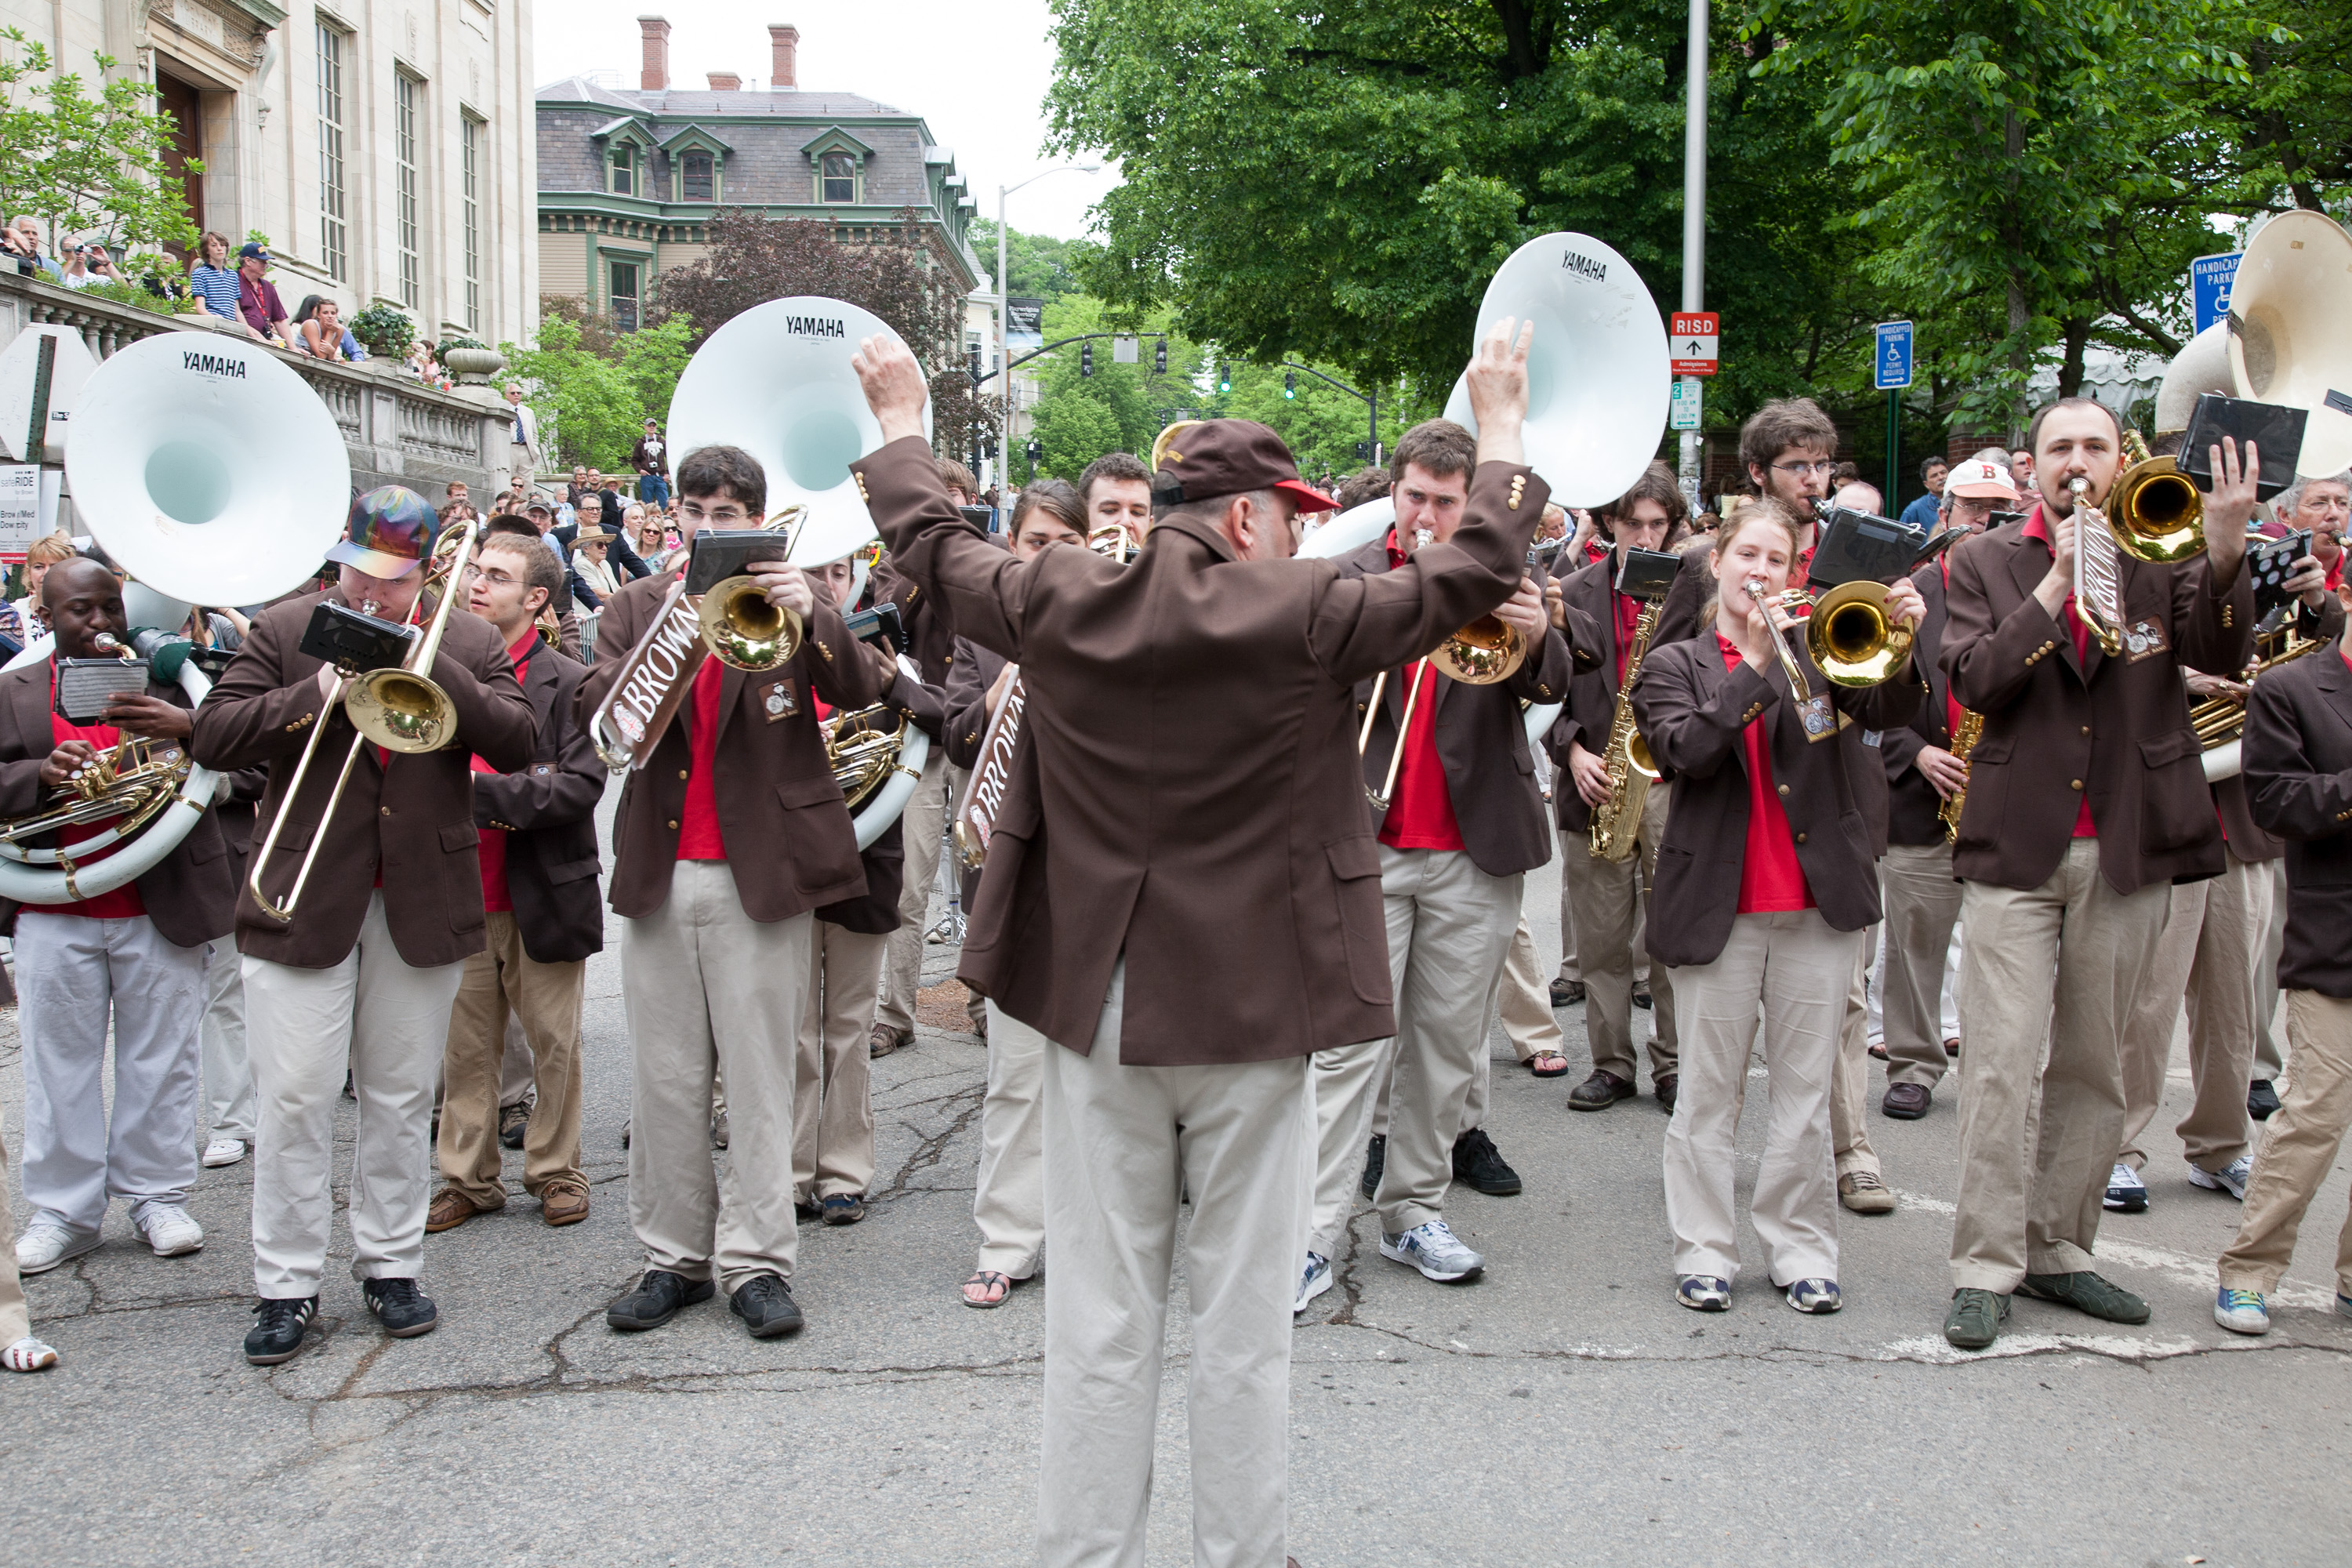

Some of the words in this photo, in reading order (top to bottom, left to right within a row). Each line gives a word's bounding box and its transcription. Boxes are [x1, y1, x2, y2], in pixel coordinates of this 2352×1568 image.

[1562, 250, 1606, 282] YAMAHA
[786, 316, 844, 338] YAMAHA
[1676, 318, 1713, 333] RISD
[1879, 325, 1910, 335] HANDICAPPED
[1885, 334, 1904, 343] PARKING
[183, 350, 246, 379] YAMAHA
[1674, 386, 1680, 395] 2
[1982, 465, 1996, 479] B
[1, 477, 34, 487] safeRIDE
[2084, 514, 2117, 610] BROWN
[622, 592, 700, 724] BROWN
[2130, 651, 2151, 661] BROWN
[2151, 644, 2167, 654] BAND
